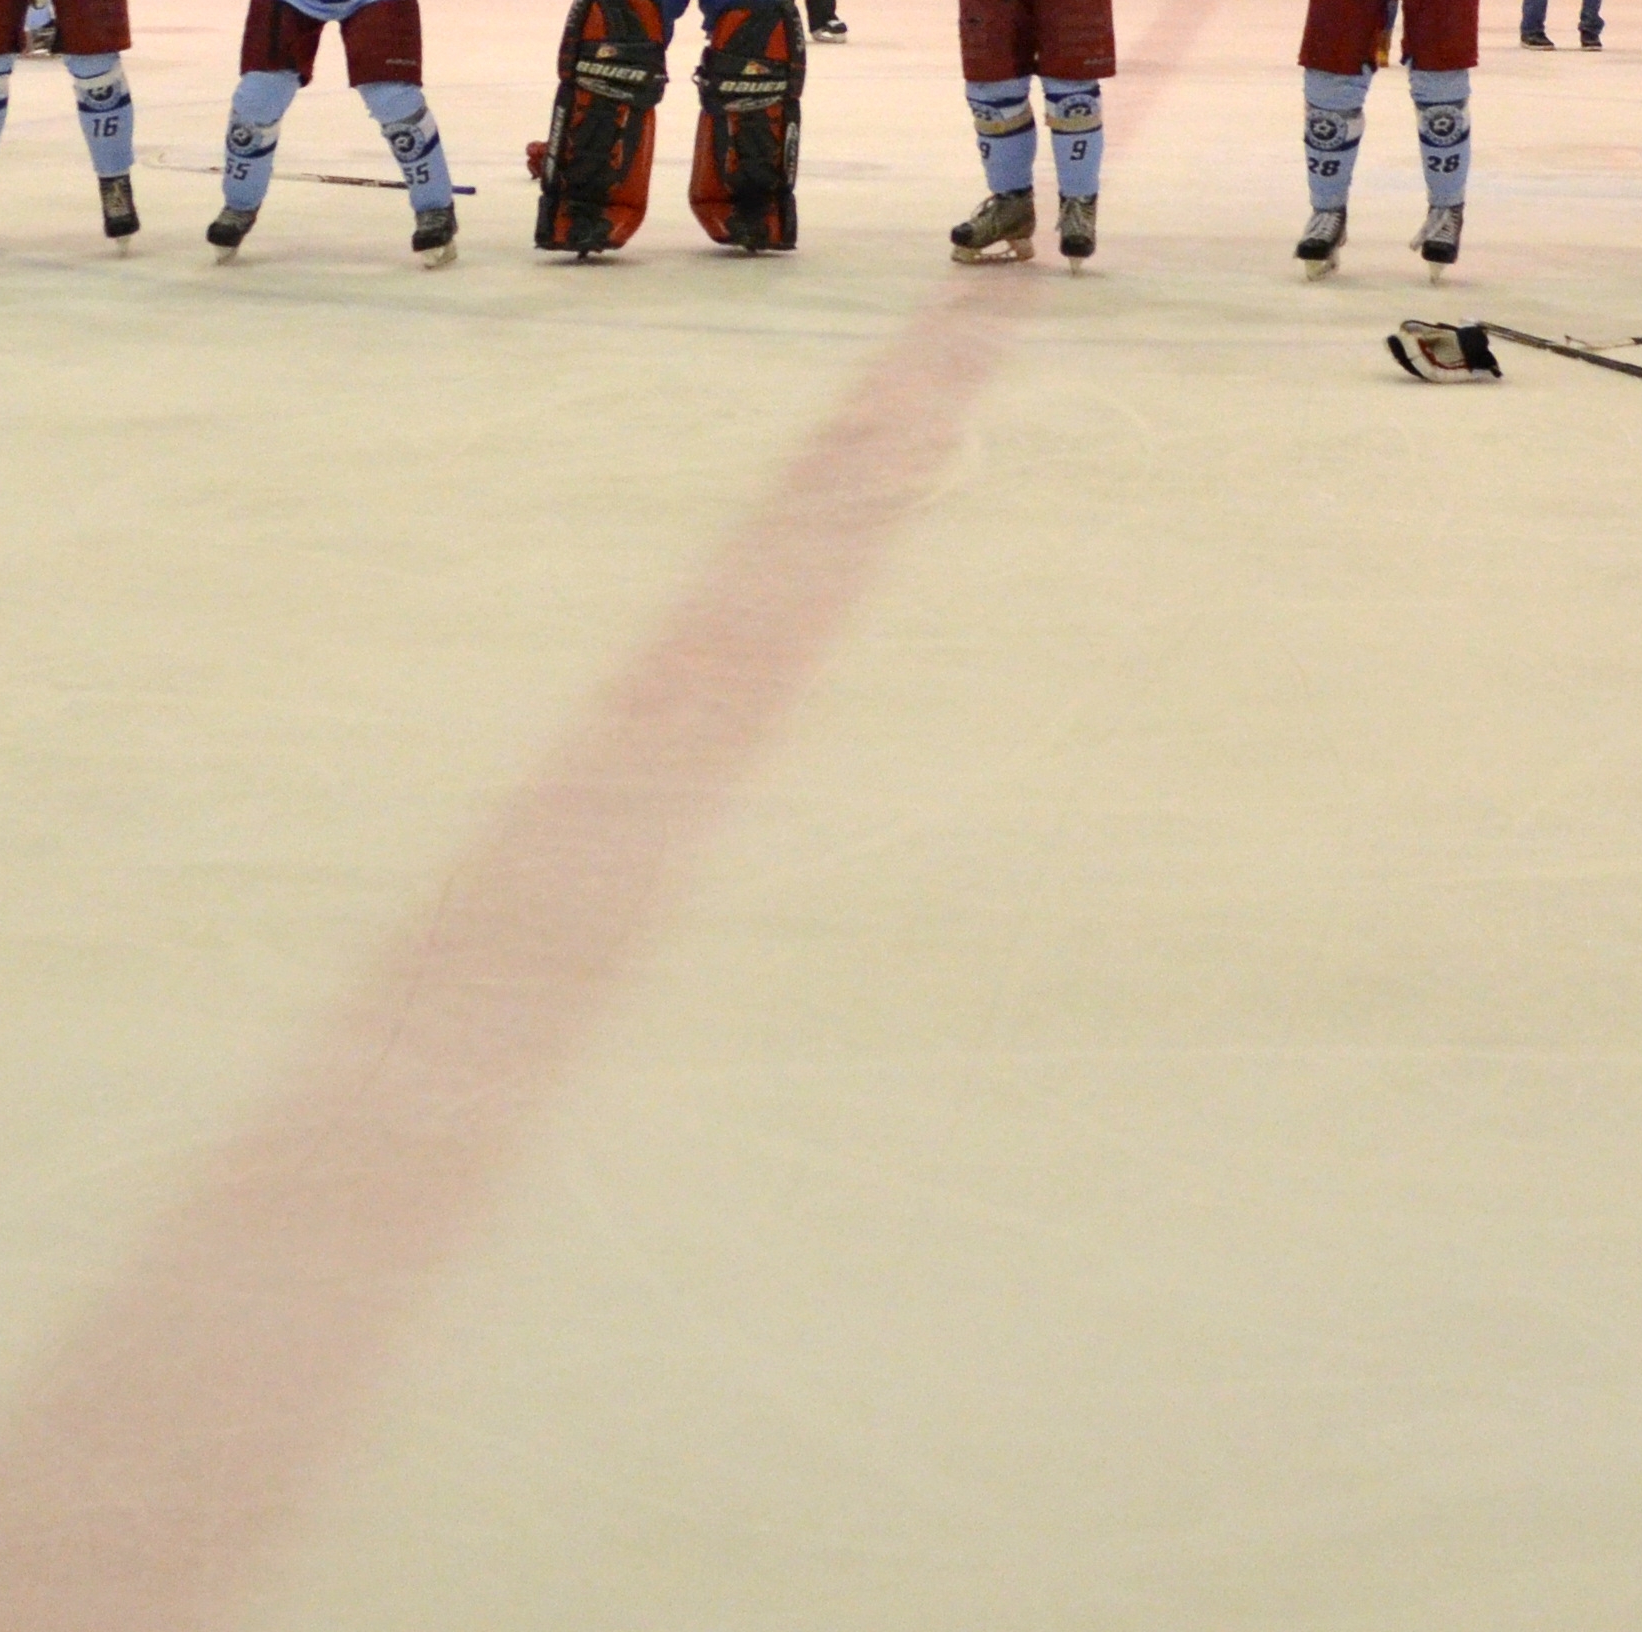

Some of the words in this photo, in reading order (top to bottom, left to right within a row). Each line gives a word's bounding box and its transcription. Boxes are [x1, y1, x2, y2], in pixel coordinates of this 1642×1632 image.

[575, 60, 648, 82] BAUER
[718, 80, 789, 93] BAUER
[92, 116, 118, 138] 16
[1070, 139, 1087, 161] 9
[1307, 156, 1341, 178] 28
[1425, 153, 1460, 173] 28
